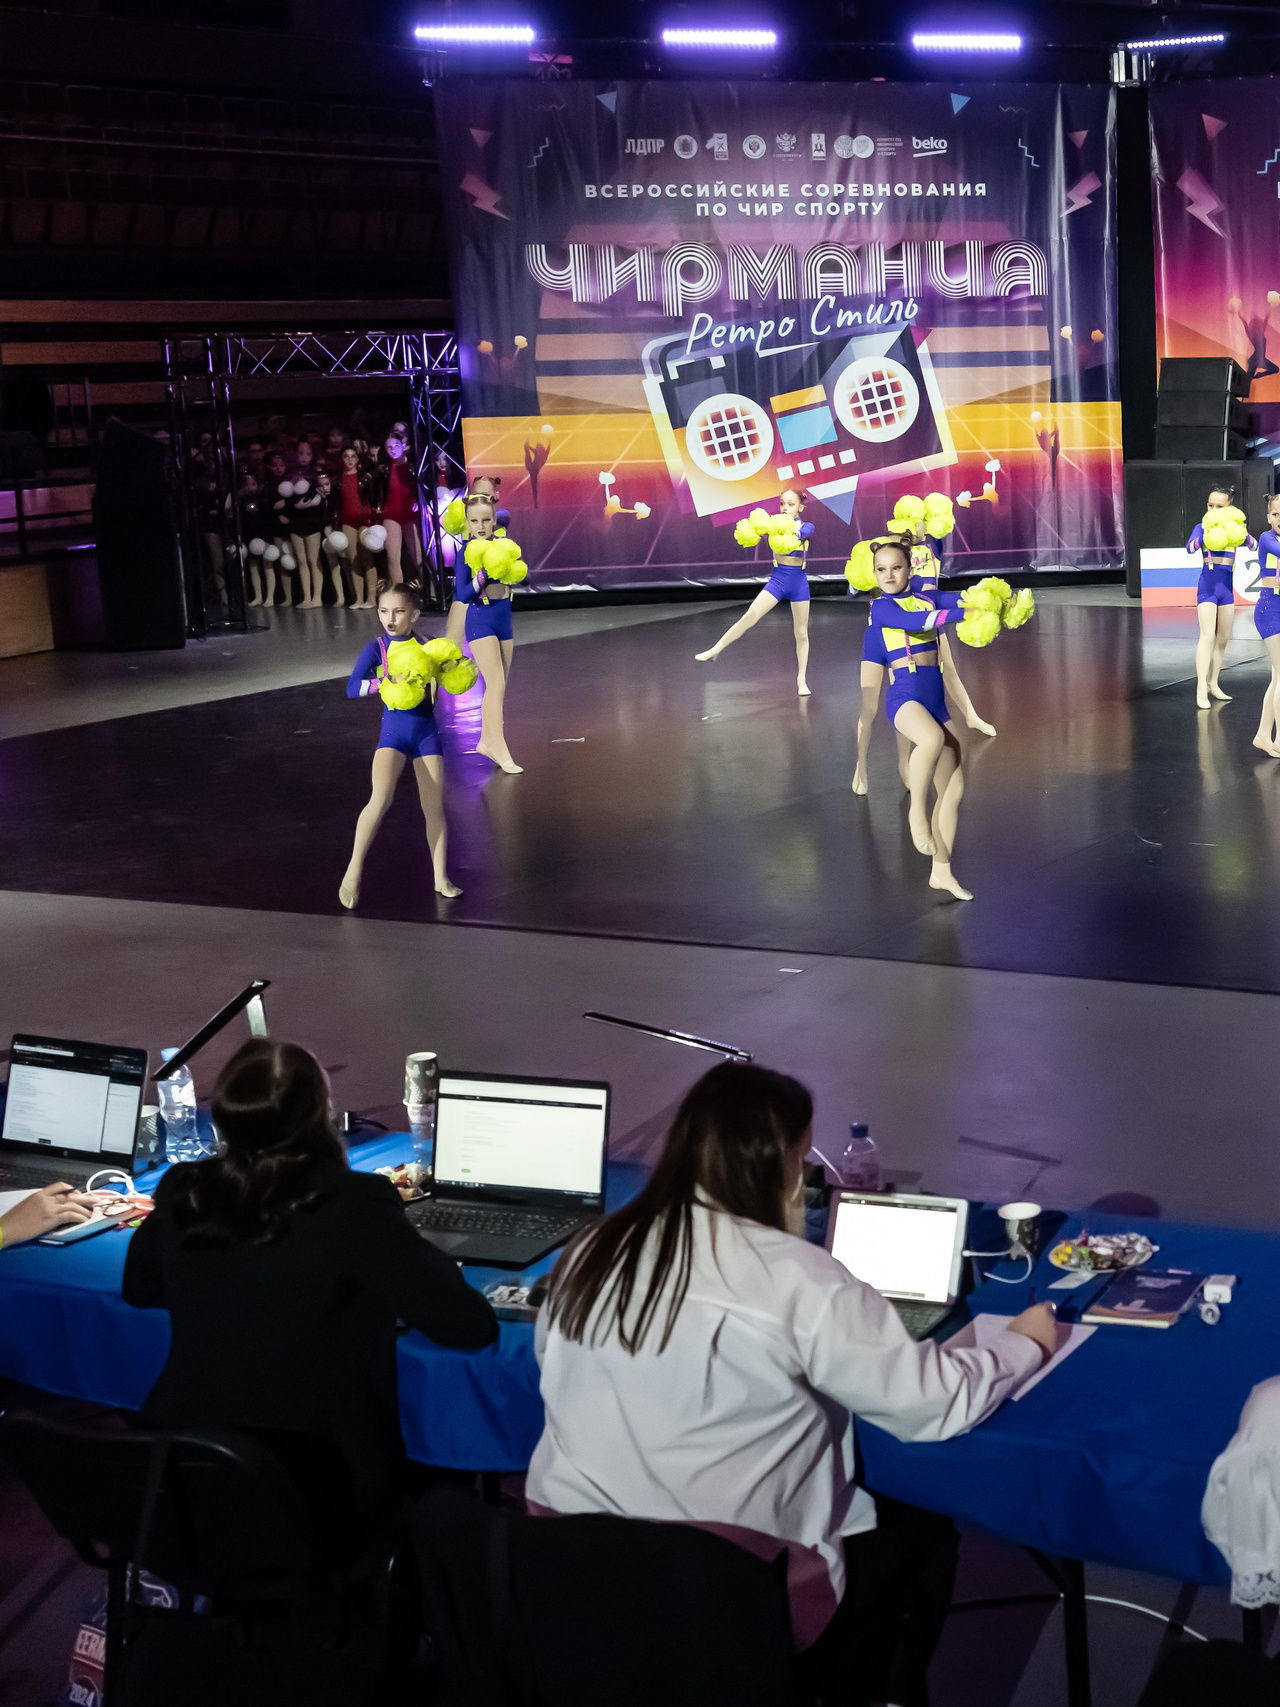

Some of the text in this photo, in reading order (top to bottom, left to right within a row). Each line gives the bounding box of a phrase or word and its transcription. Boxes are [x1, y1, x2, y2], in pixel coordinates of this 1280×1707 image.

[625, 138, 665, 155] ЛДПР
[911, 136, 948, 150] beko
[584, 180, 988, 199] ВСЕРОССИЙСКИЕ СОРЕВНОВАНИЯ
[696, 202, 885, 217] ПО ЧИР СПОРТУ
[685, 295, 919, 357] Ретро Стиль
[1244, 558, 1262, 593] 2
